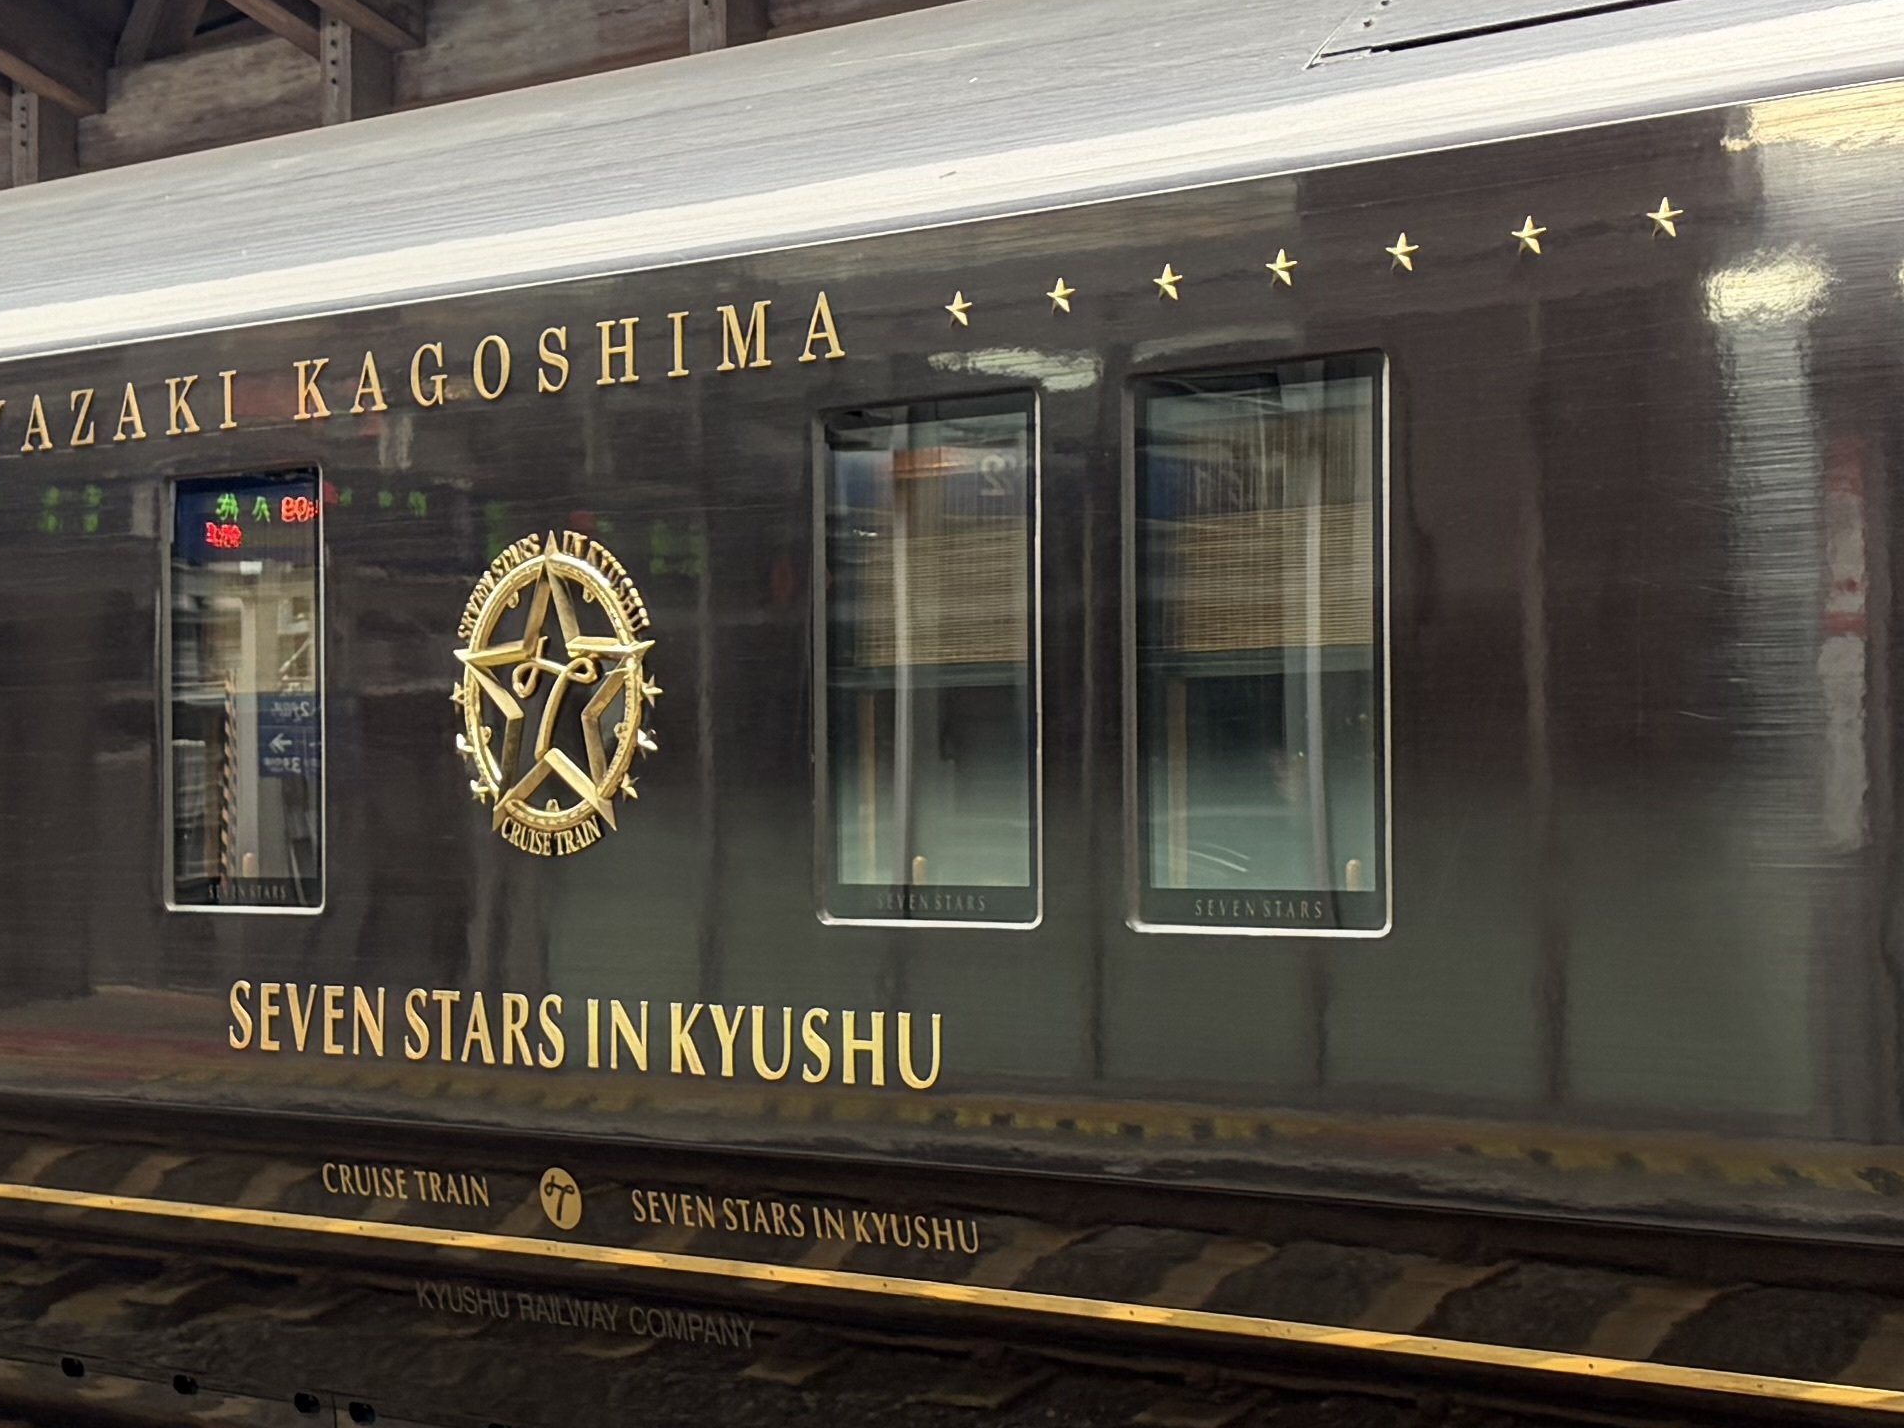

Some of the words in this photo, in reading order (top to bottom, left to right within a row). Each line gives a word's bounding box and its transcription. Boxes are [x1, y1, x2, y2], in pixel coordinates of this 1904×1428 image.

[292, 290, 847, 421] KAGOSHIMA
[501, 816, 553, 857] CRUISE
[553, 815, 602, 857] TRAIN
[1193, 898, 1256, 917] SEVEN
[1261, 900, 1324, 920] STARS
[228, 980, 387, 1057] SEVEN
[403, 987, 567, 1070] STARS
[587, 998, 650, 1071] IN
[669, 1002, 943, 1091] KYUSHU
[322, 1162, 408, 1200] CRUISE
[413, 1170, 491, 1209] TRAIN
[631, 1188, 716, 1230] SEVEN
[721, 1196, 805, 1238] STARS
[813, 1205, 846, 1242] IN
[852, 1210, 980, 1255] KYUSHU
[415, 1280, 510, 1320] KYUSHU
[517, 1291, 621, 1332] RAILWAY
[628, 1306, 754, 1350] COMPANY
